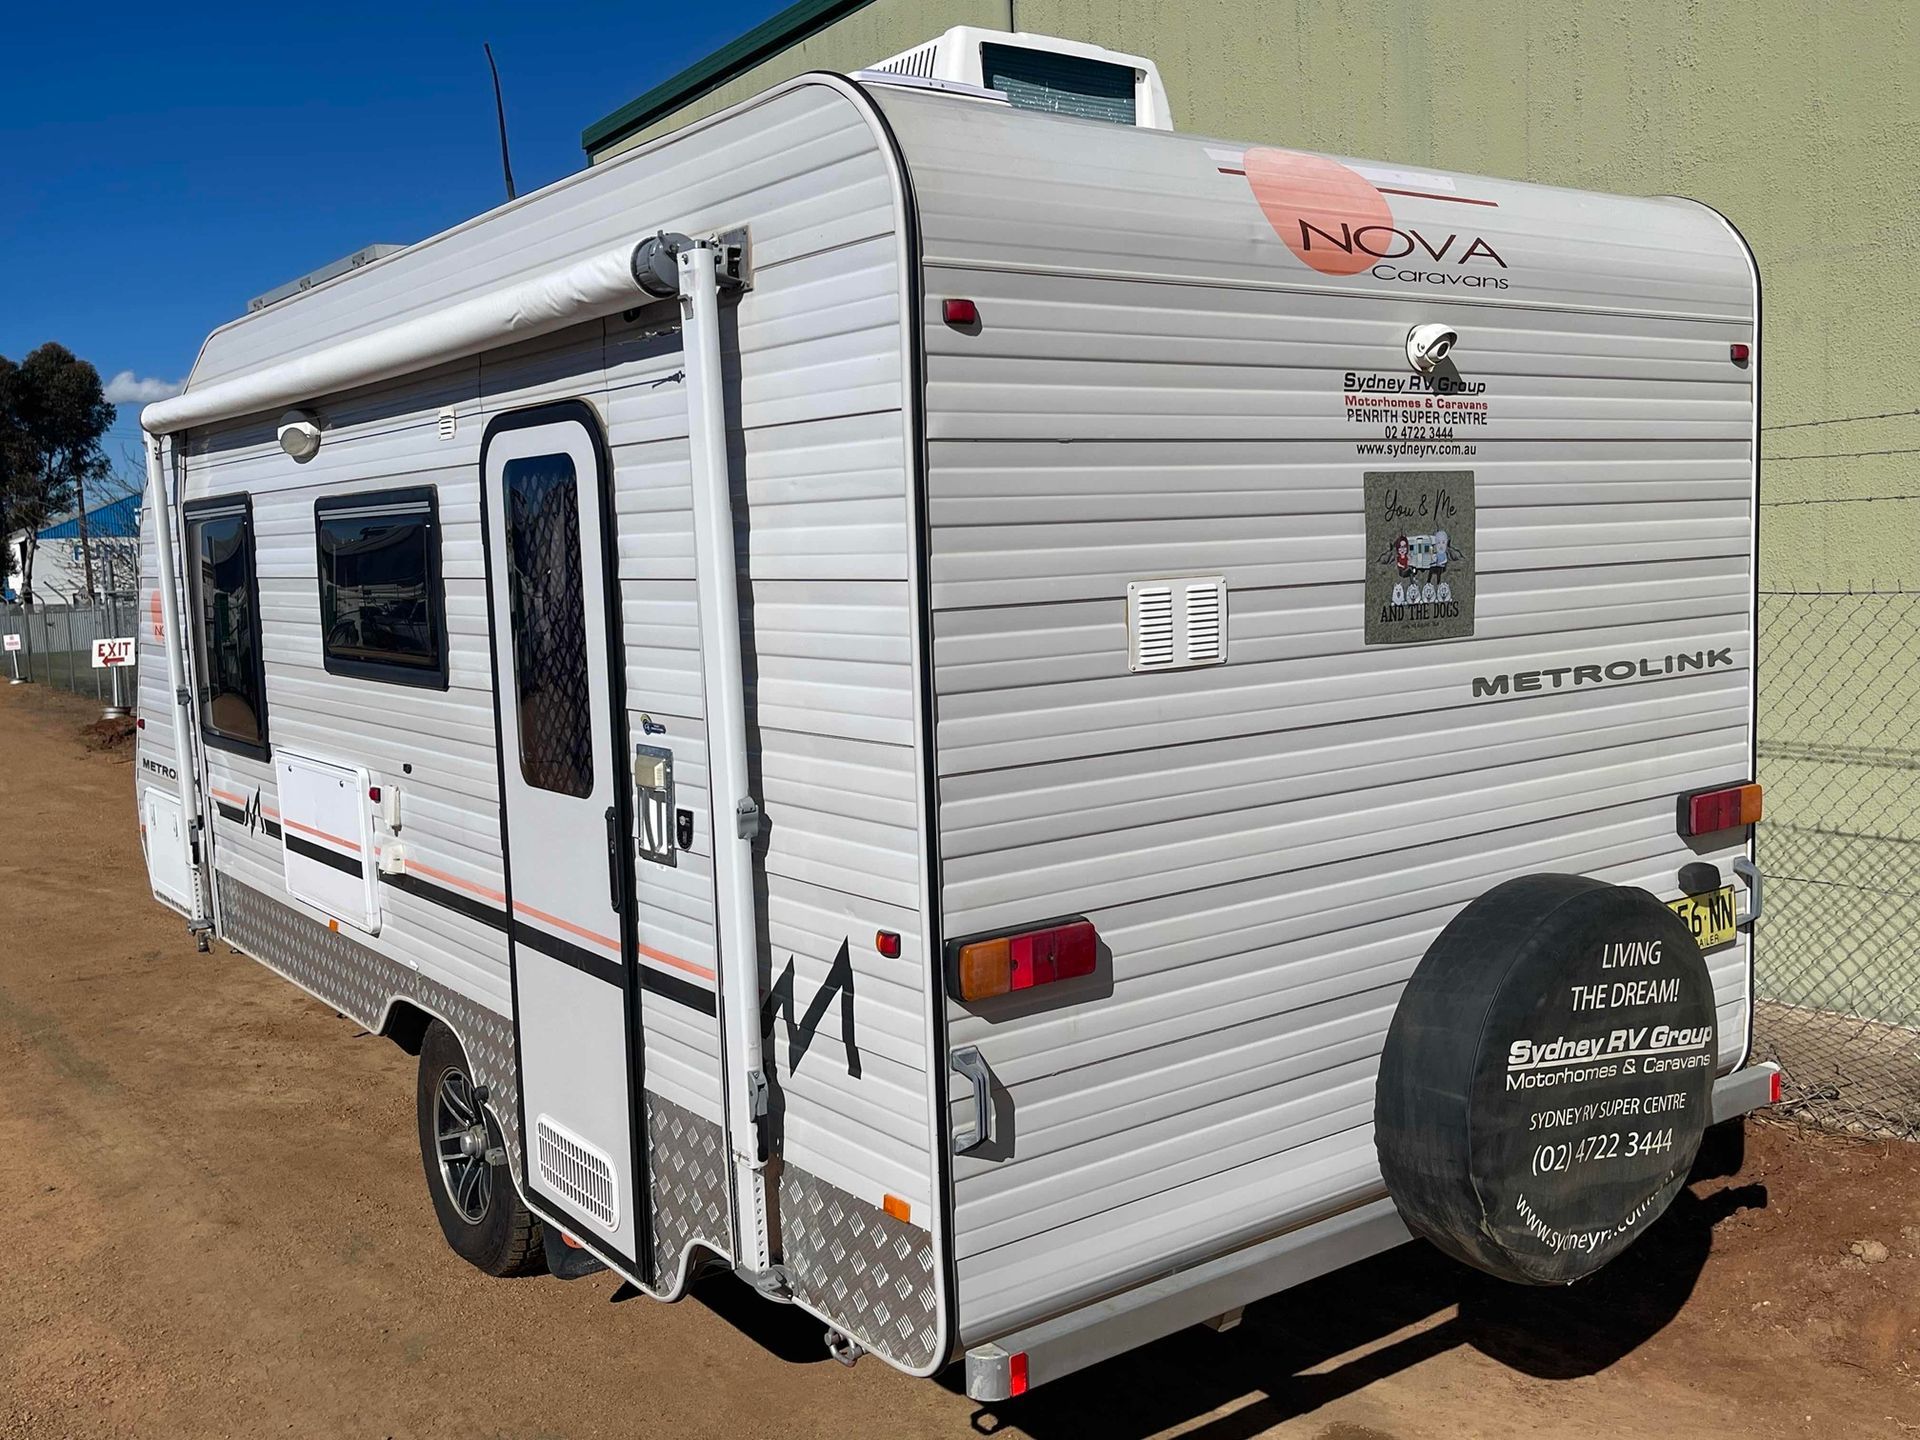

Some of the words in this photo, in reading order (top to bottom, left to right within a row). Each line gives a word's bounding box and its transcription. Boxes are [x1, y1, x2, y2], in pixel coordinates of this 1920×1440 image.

[1298, 218, 1508, 268] NOVA
[1372, 264, 1509, 290] Caravans
[1344, 372, 1405, 393] Sydney
[1409, 376, 1434, 391] RV
[1438, 377, 1486, 394] Group
[1345, 395, 1421, 408] Motorhomes
[1425, 398, 1433, 408] &
[1437, 398, 1488, 410] Caravans
[1347, 409, 1398, 423] PENRITH
[1402, 410, 1440, 424] SUPER
[1444, 411, 1488, 425] CENTRE
[1385, 426, 1397, 439] 02
[1401, 426, 1426, 439] 4722
[1429, 427, 1453, 439] 3444
[1357, 442, 1477, 458] www.sydneyrv.com.au
[1384, 489, 1414, 522] You
[1419, 494, 1428, 516] &
[1433, 489, 1457, 521] Me
[1380, 604, 1404, 622] AND
[1408, 602, 1429, 620] THE
[1433, 601, 1459, 619] DOGS
[98, 642, 131, 657] EXIT
[1472, 647, 1733, 698] METROLINK
[143, 758, 178, 780] METRO
[1602, 940, 1662, 969] LIVING
[1571, 984, 1608, 1012] THE
[1610, 978, 1680, 1008] DREAM!
[1508, 1036, 1604, 1068] Sydney
[1607, 1027, 1648, 1053] RV
[1650, 1024, 1713, 1049] Group
[1506, 1064, 1618, 1092] Motorhomes
[1622, 1058, 1636, 1075] &
[1643, 1053, 1711, 1074] Caravans
[1529, 1106, 1583, 1131] SYDNEY
[1582, 1103, 1600, 1122] RV
[1599, 1097, 1640, 1119] SUPER
[1643, 1092, 1687, 1115] CENTRE
[1532, 1141, 1573, 1176] (02)
[1575, 1132, 1620, 1163] 4722
[1624, 1127, 1673, 1157] 3444
